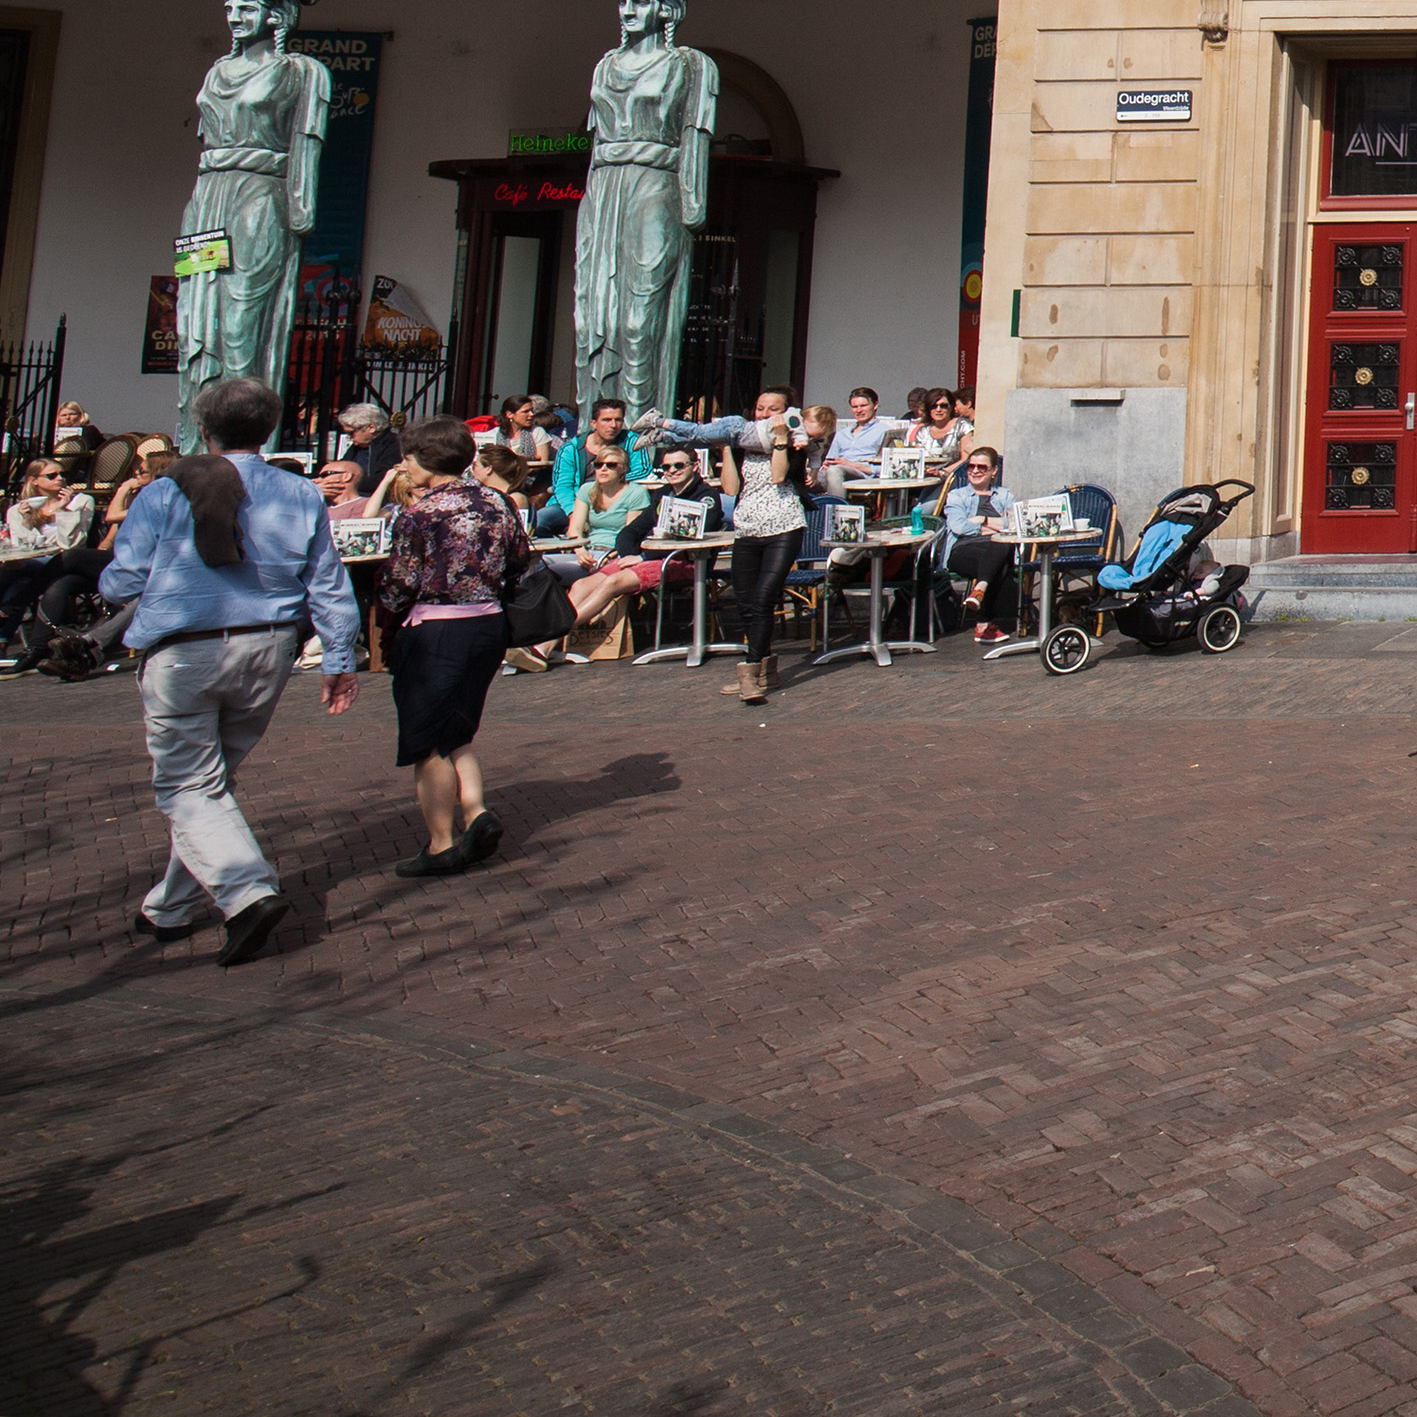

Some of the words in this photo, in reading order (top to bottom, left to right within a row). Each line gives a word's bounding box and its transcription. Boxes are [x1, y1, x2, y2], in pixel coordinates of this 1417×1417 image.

[287, 38, 367, 54] GRAND
[317, 56, 375, 71] PART
[1119, 92, 1189, 106] Oudegracht
[494, 184, 527, 205] Café
[377, 316, 426, 329] KONING
[382, 329, 421, 342] NACHT
